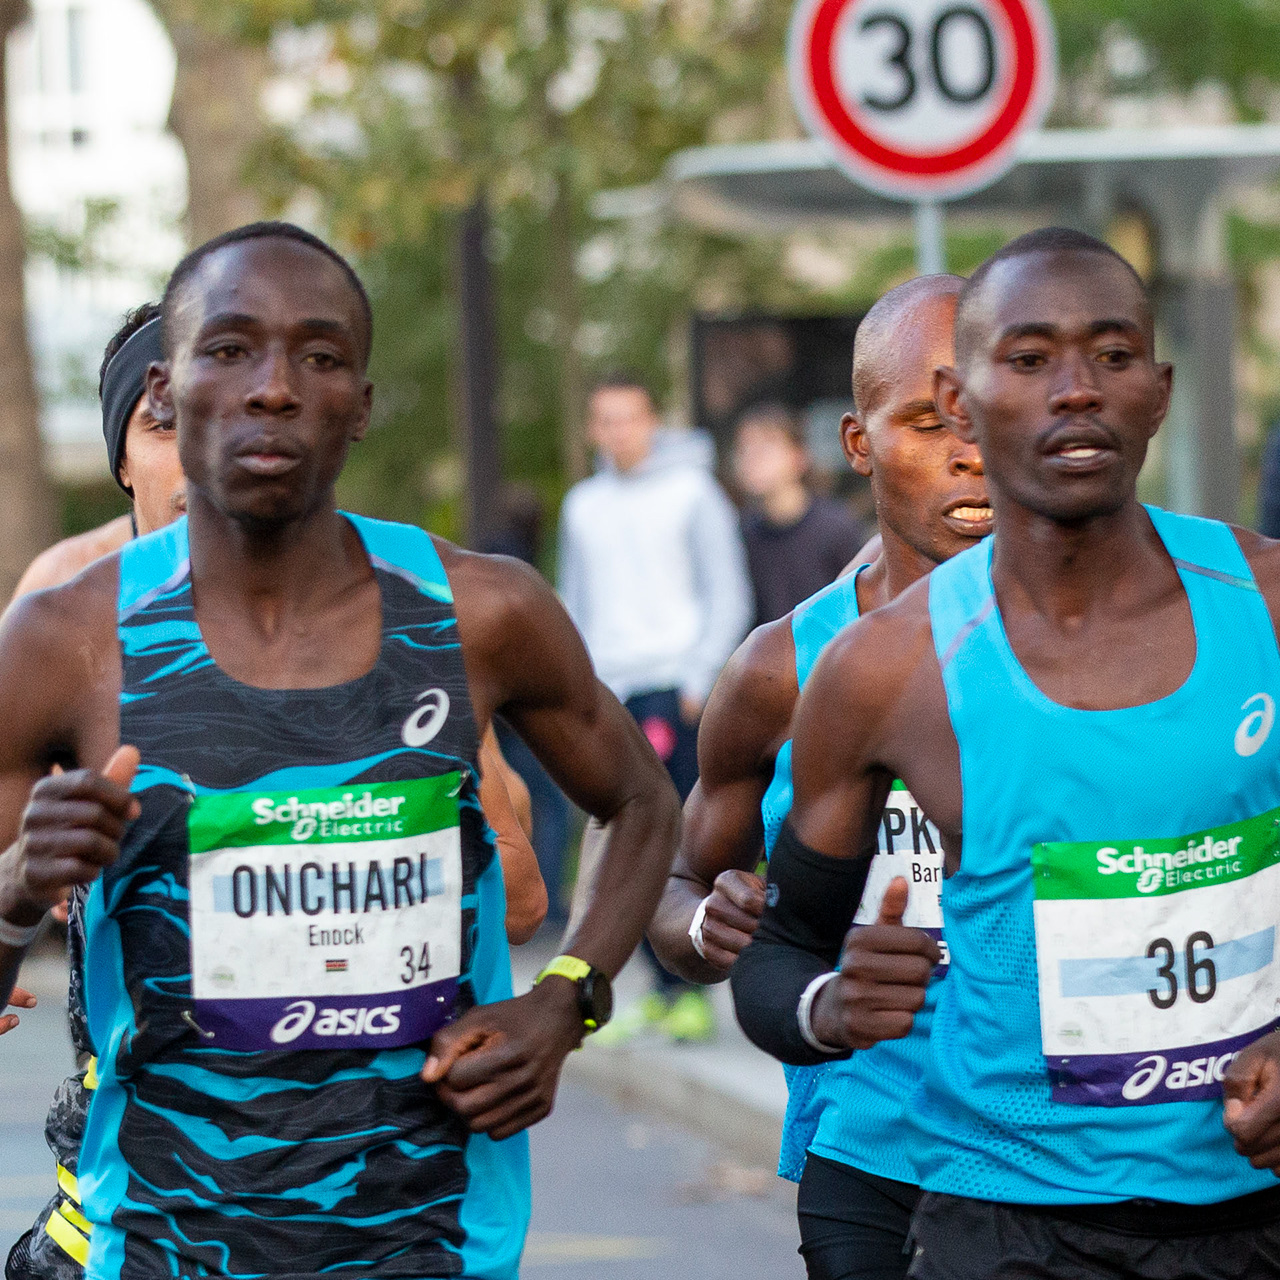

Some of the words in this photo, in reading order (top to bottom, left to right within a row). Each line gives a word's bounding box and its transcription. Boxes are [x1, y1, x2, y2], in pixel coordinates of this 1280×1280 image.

[858, 6, 996, 113] 30
[251, 792, 406, 825] Schneider
[320, 818, 404, 838] Electric
[911, 862, 941, 883] Bar
[1095, 835, 1244, 876] Schneider
[1165, 859, 1243, 888] Electric
[231, 852, 428, 919] ONCHARI
[308, 922, 365, 947] Enock
[399, 941, 433, 985] 34
[1145, 930, 1218, 1010] 36
